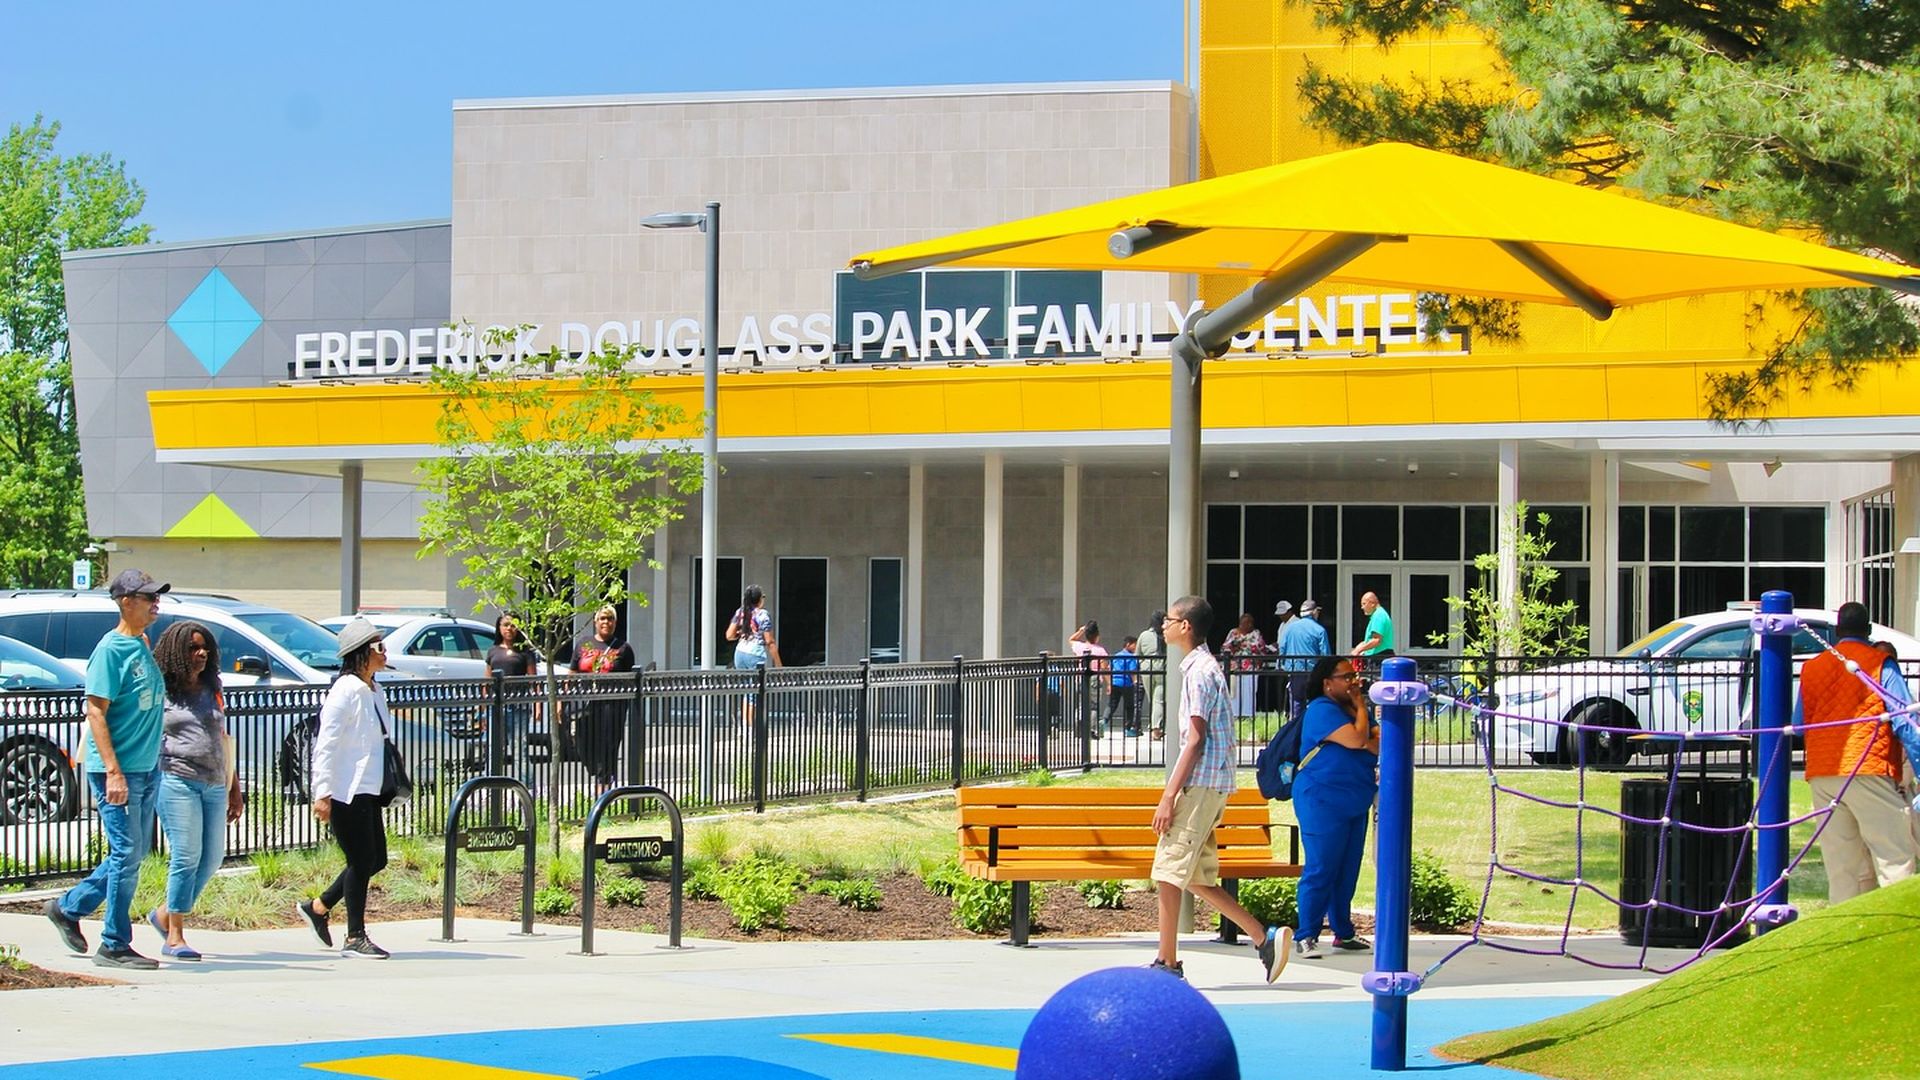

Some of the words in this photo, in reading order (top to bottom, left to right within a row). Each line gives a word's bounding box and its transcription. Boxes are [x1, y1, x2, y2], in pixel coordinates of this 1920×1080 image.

[295, 323, 545, 378] FREDERICK
[561, 312, 832, 368] DOUGASS
[852, 307, 992, 360] PARK
[1008, 300, 1205, 356] FAMILY
[1231, 293, 1451, 349] ENTE
